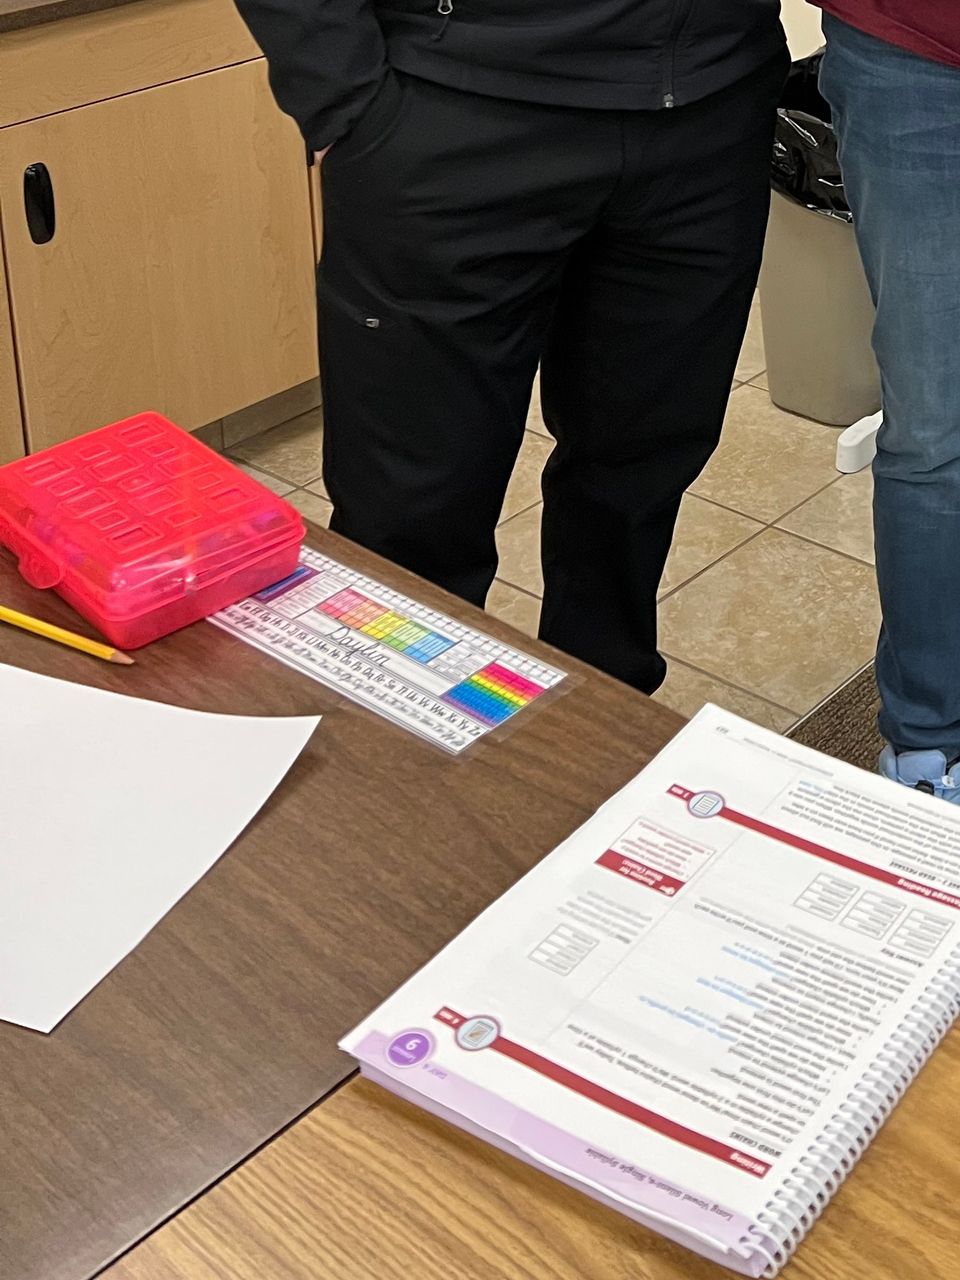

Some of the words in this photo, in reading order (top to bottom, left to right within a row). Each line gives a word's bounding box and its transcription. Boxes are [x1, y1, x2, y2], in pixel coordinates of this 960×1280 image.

[896, 878, 932, 896] Reading
[406, 1040, 420, 1050] 9
[730, 1131, 758, 1147] CHAINS
[584, 1148, 618, 1168] Syllable
[758, 1144, 782, 1158] WORD
[730, 1152, 766, 1173] Writing
[619, 1162, 646, 1182] Single
[682, 1194, 710, 1210] Vowel
[710, 1203, 734, 1222] Long
